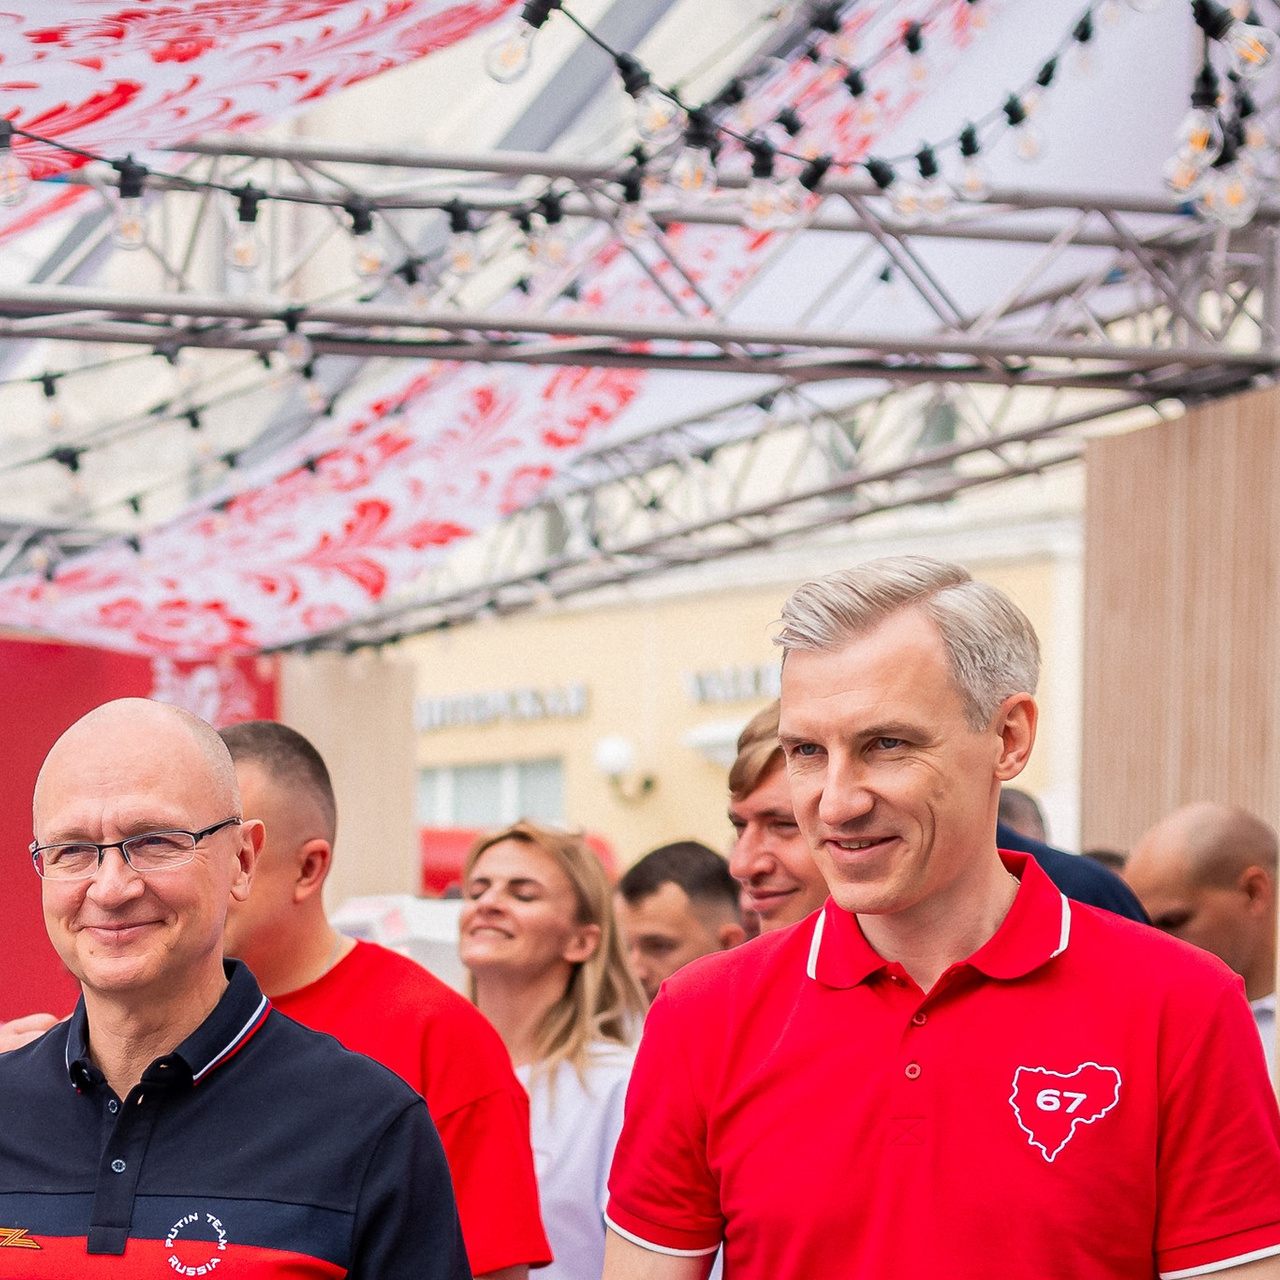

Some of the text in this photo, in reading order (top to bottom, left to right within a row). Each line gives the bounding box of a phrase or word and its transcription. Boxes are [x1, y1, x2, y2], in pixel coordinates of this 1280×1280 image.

[1036, 1089, 1087, 1114] 67
[165, 1212, 228, 1250] PUTIN TEAM
[168, 1255, 221, 1276] RUSSIA
